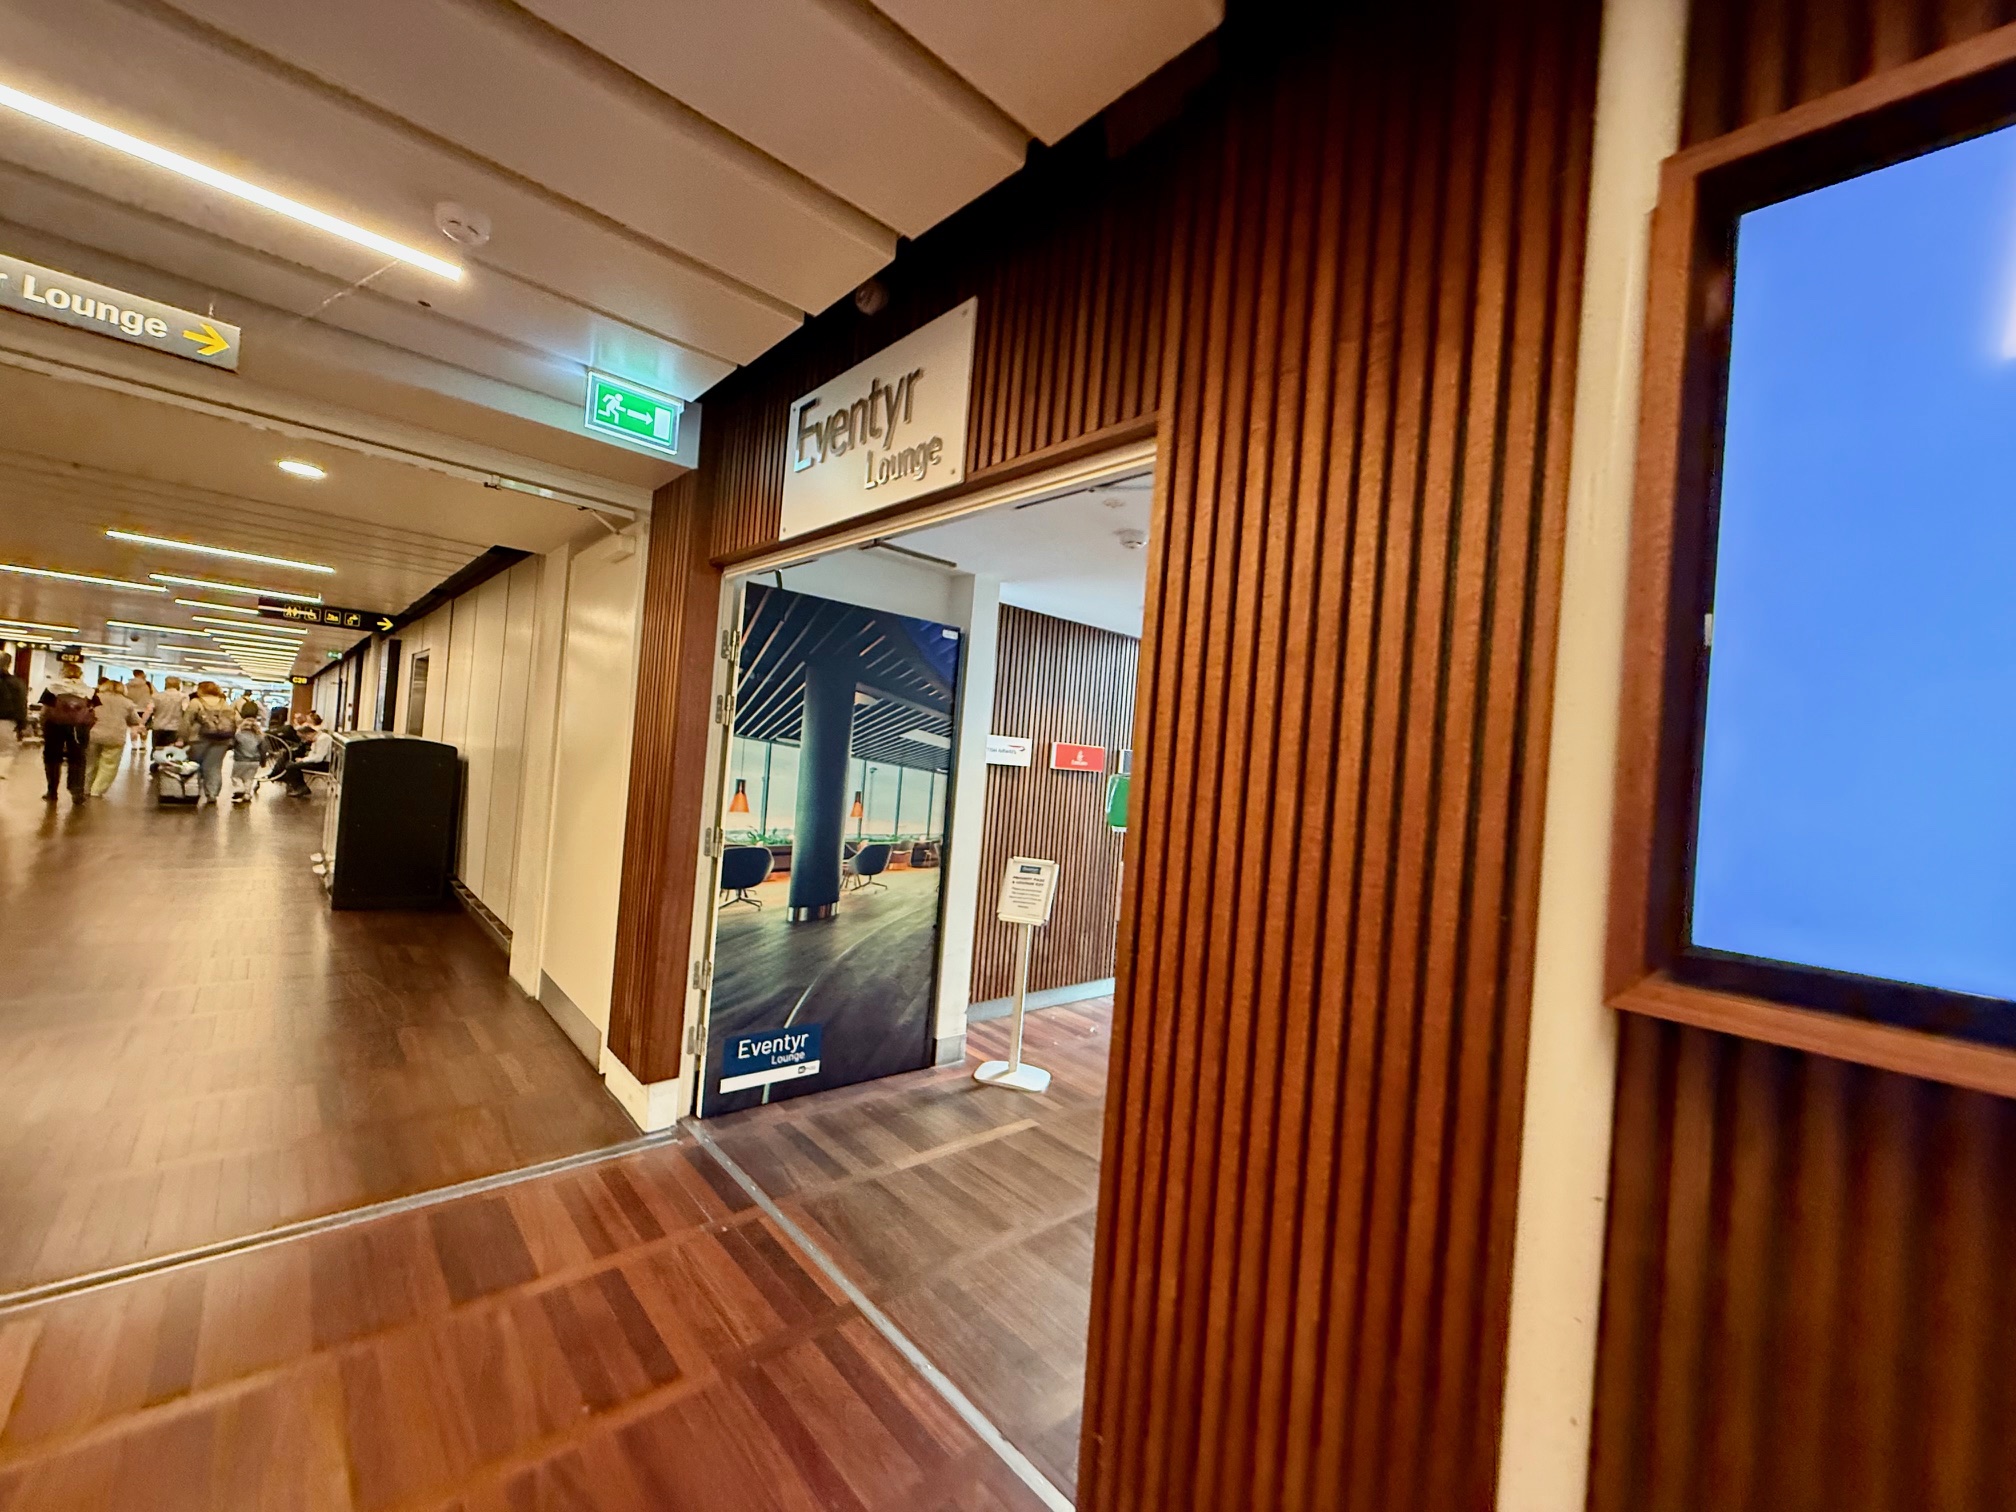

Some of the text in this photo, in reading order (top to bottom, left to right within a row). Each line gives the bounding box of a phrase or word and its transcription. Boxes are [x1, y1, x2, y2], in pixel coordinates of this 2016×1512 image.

[22, 274, 168, 338] Lounge
[793, 367, 924, 473] Eventyr
[864, 435, 943, 490] Lounge
[738, 1033, 809, 1059] Eventyr
[771, 1050, 805, 1065] Lounge
